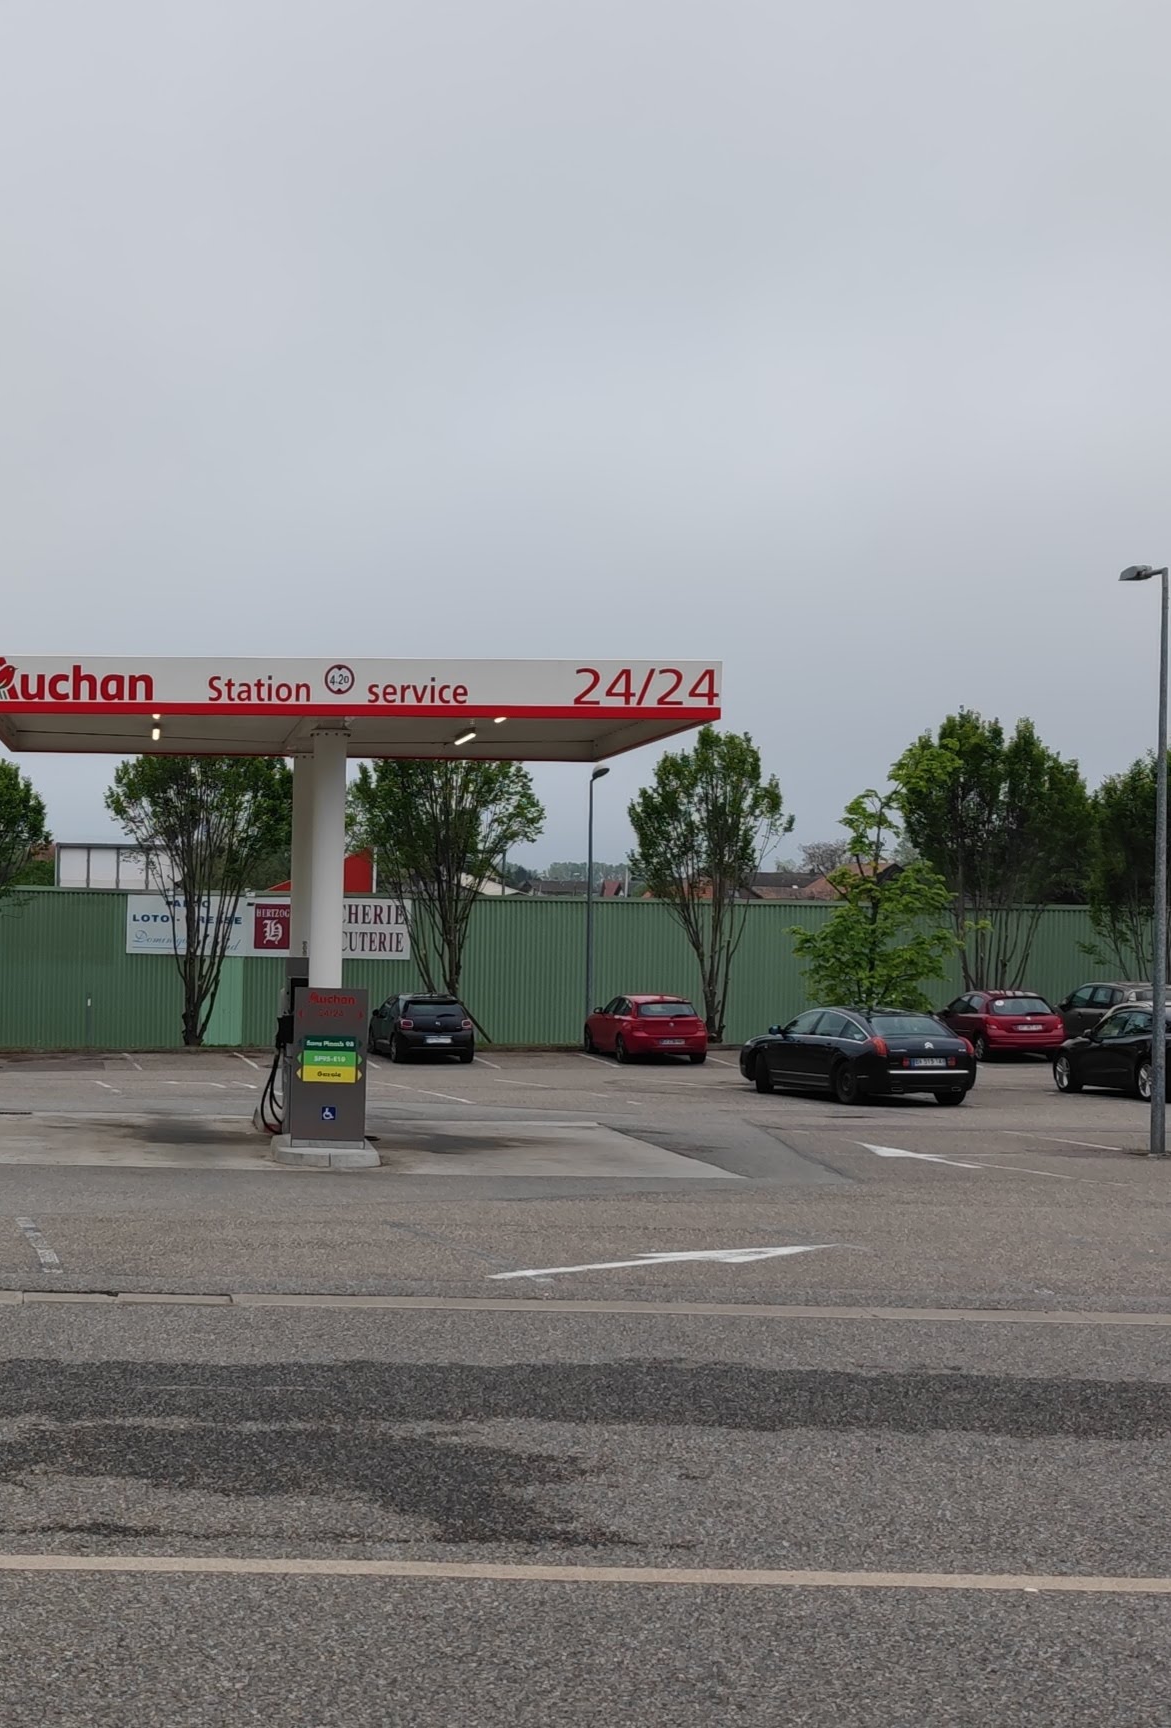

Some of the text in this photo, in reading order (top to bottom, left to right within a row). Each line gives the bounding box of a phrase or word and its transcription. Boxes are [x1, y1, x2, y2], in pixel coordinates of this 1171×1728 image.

[208, 675, 312, 703] Station
[366, 676, 469, 705] service
[573, 667, 720, 706] 24/24
[132, 914, 170, 923] LOTO
[256, 908, 290, 918] HERTZOG
